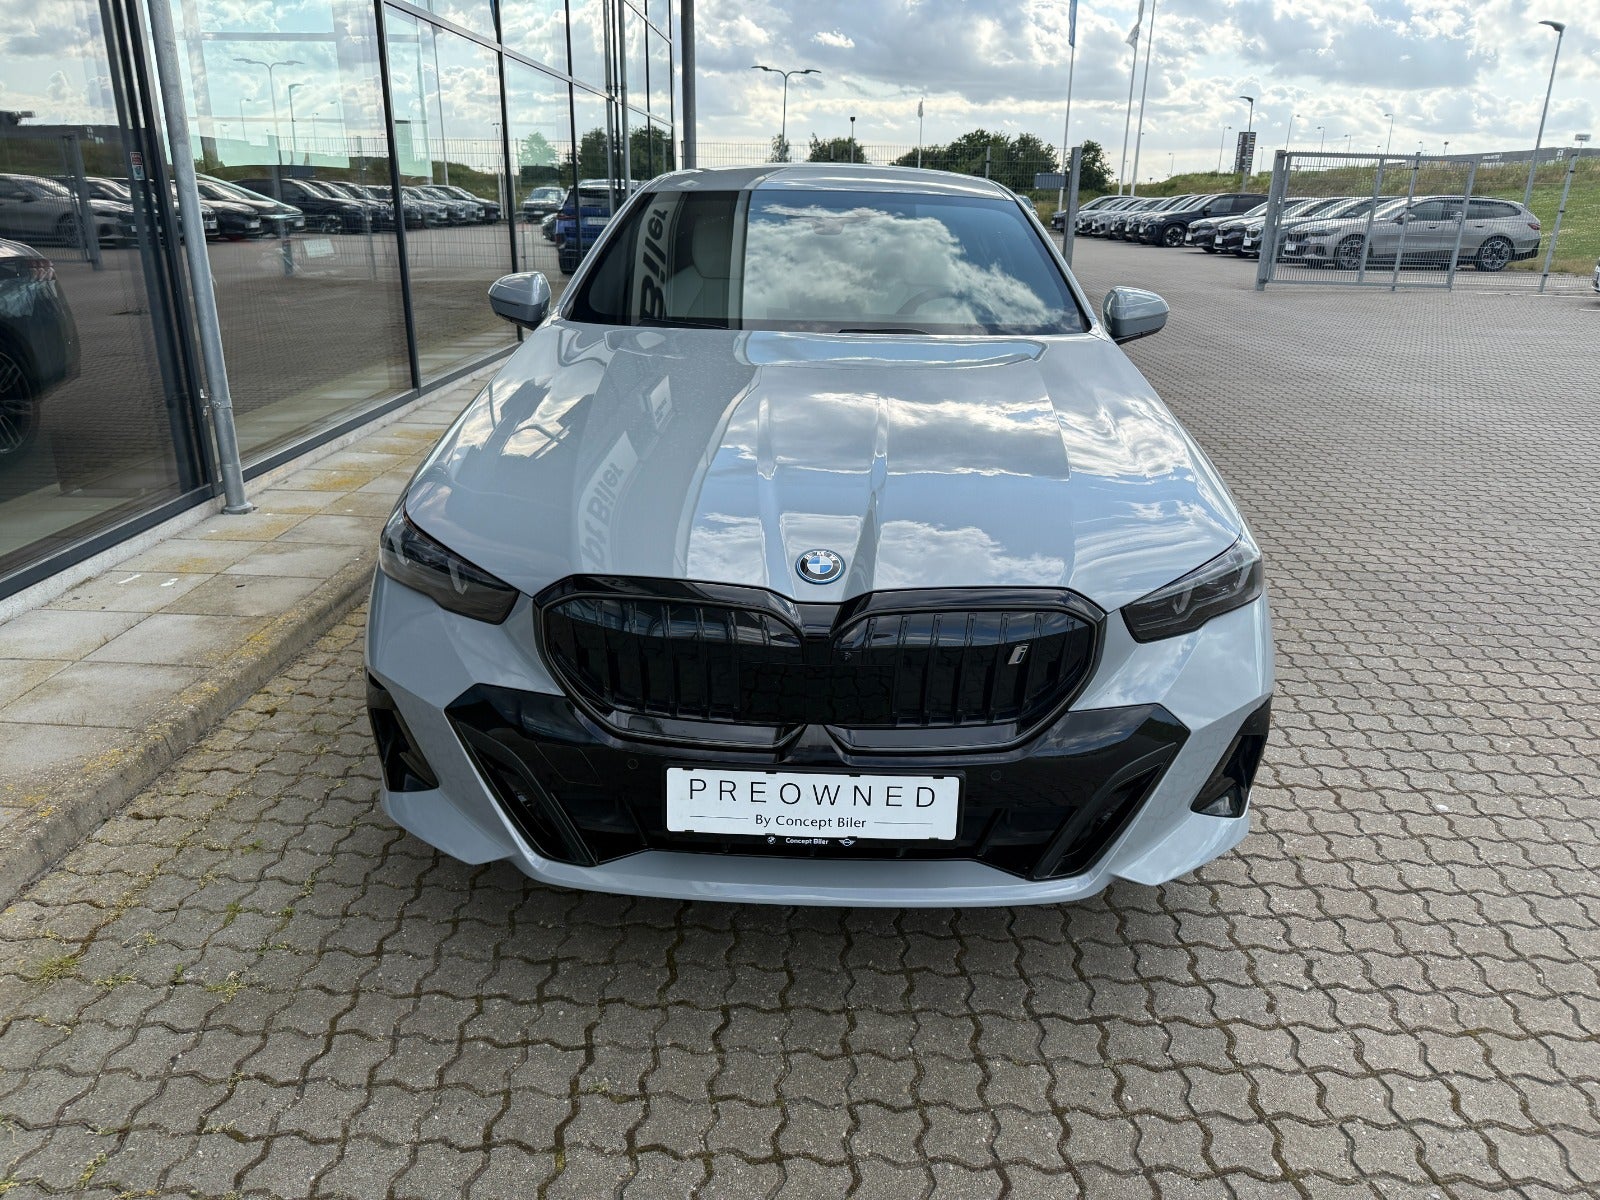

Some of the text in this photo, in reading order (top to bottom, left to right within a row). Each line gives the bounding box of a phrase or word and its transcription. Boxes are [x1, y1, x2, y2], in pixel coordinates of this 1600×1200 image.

[689, 778, 936, 808] PREOWNED
[755, 813, 867, 829] By Concept Biler
[785, 837, 812, 845] Concept
